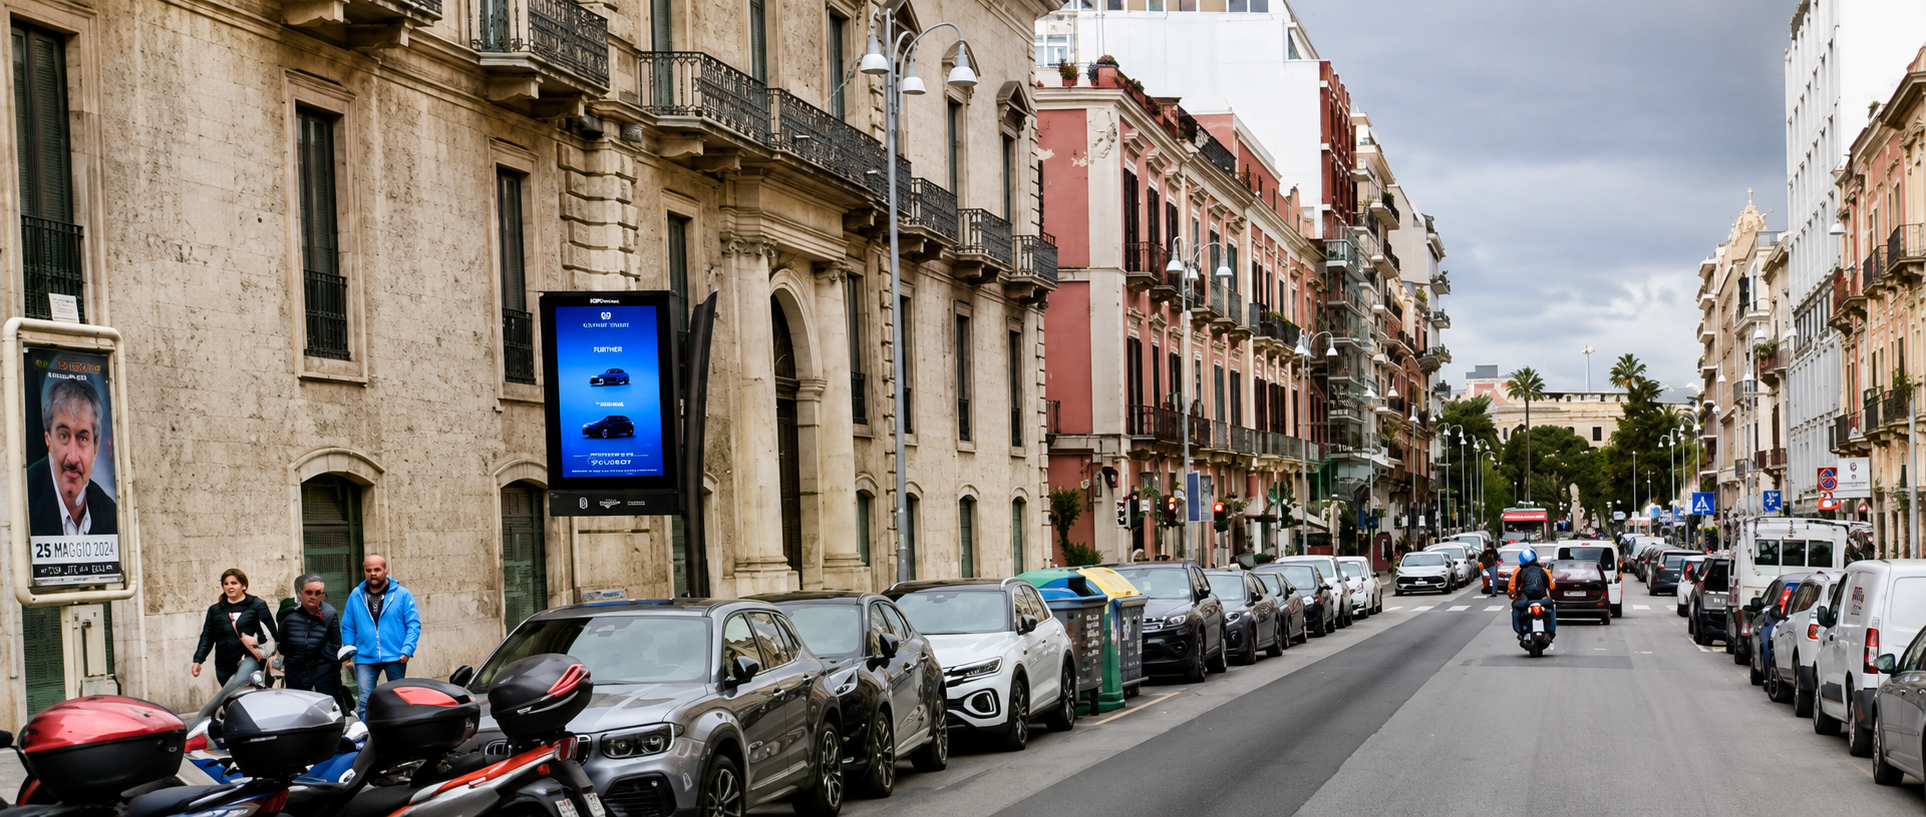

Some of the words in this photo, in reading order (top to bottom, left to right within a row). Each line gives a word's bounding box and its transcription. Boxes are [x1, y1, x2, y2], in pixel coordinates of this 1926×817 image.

[36, 543, 51, 558] 25
[54, 542, 92, 558] MAGGIO
[93, 541, 115, 557] 2024
